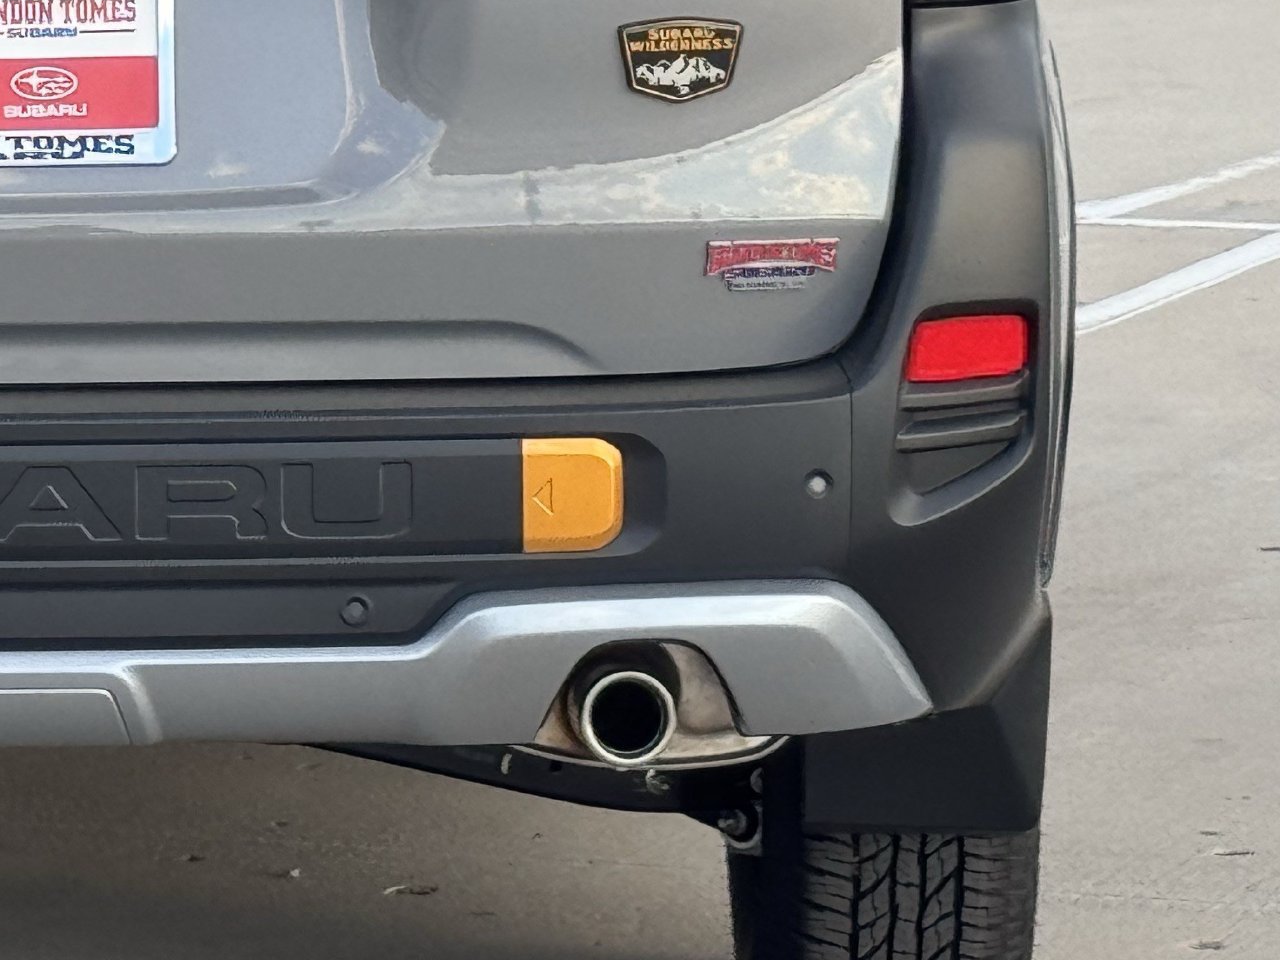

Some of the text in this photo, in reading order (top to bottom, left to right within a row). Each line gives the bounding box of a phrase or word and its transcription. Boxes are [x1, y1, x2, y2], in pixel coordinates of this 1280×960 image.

[7, 27, 78, 38] SUBARU
[648, 25, 716, 41] SUBARU
[629, 38, 734, 52] WILDERNESS
[2, 103, 89, 118] SUBARU
[4, 134, 135, 156] TOMES
